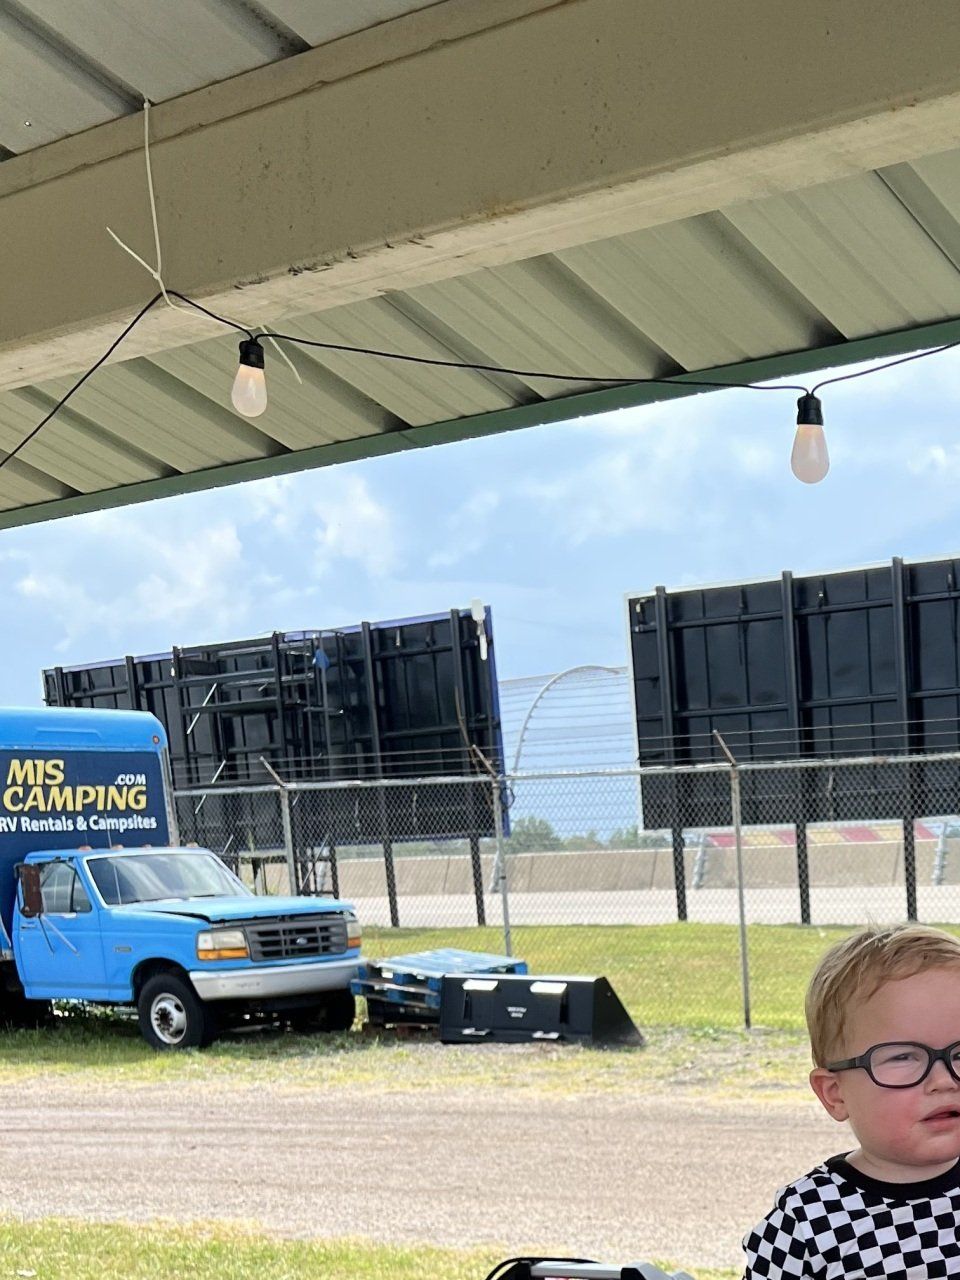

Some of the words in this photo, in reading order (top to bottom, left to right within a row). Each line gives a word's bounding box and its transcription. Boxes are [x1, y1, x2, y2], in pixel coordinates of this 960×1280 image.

[7, 759, 65, 786] MIS
[3, 785, 147, 812] CAMPING
[0, 816, 18, 832] RV
[21, 816, 74, 832] Rentals
[76, 816, 88, 831] &
[89, 814, 157, 833] Campsites
